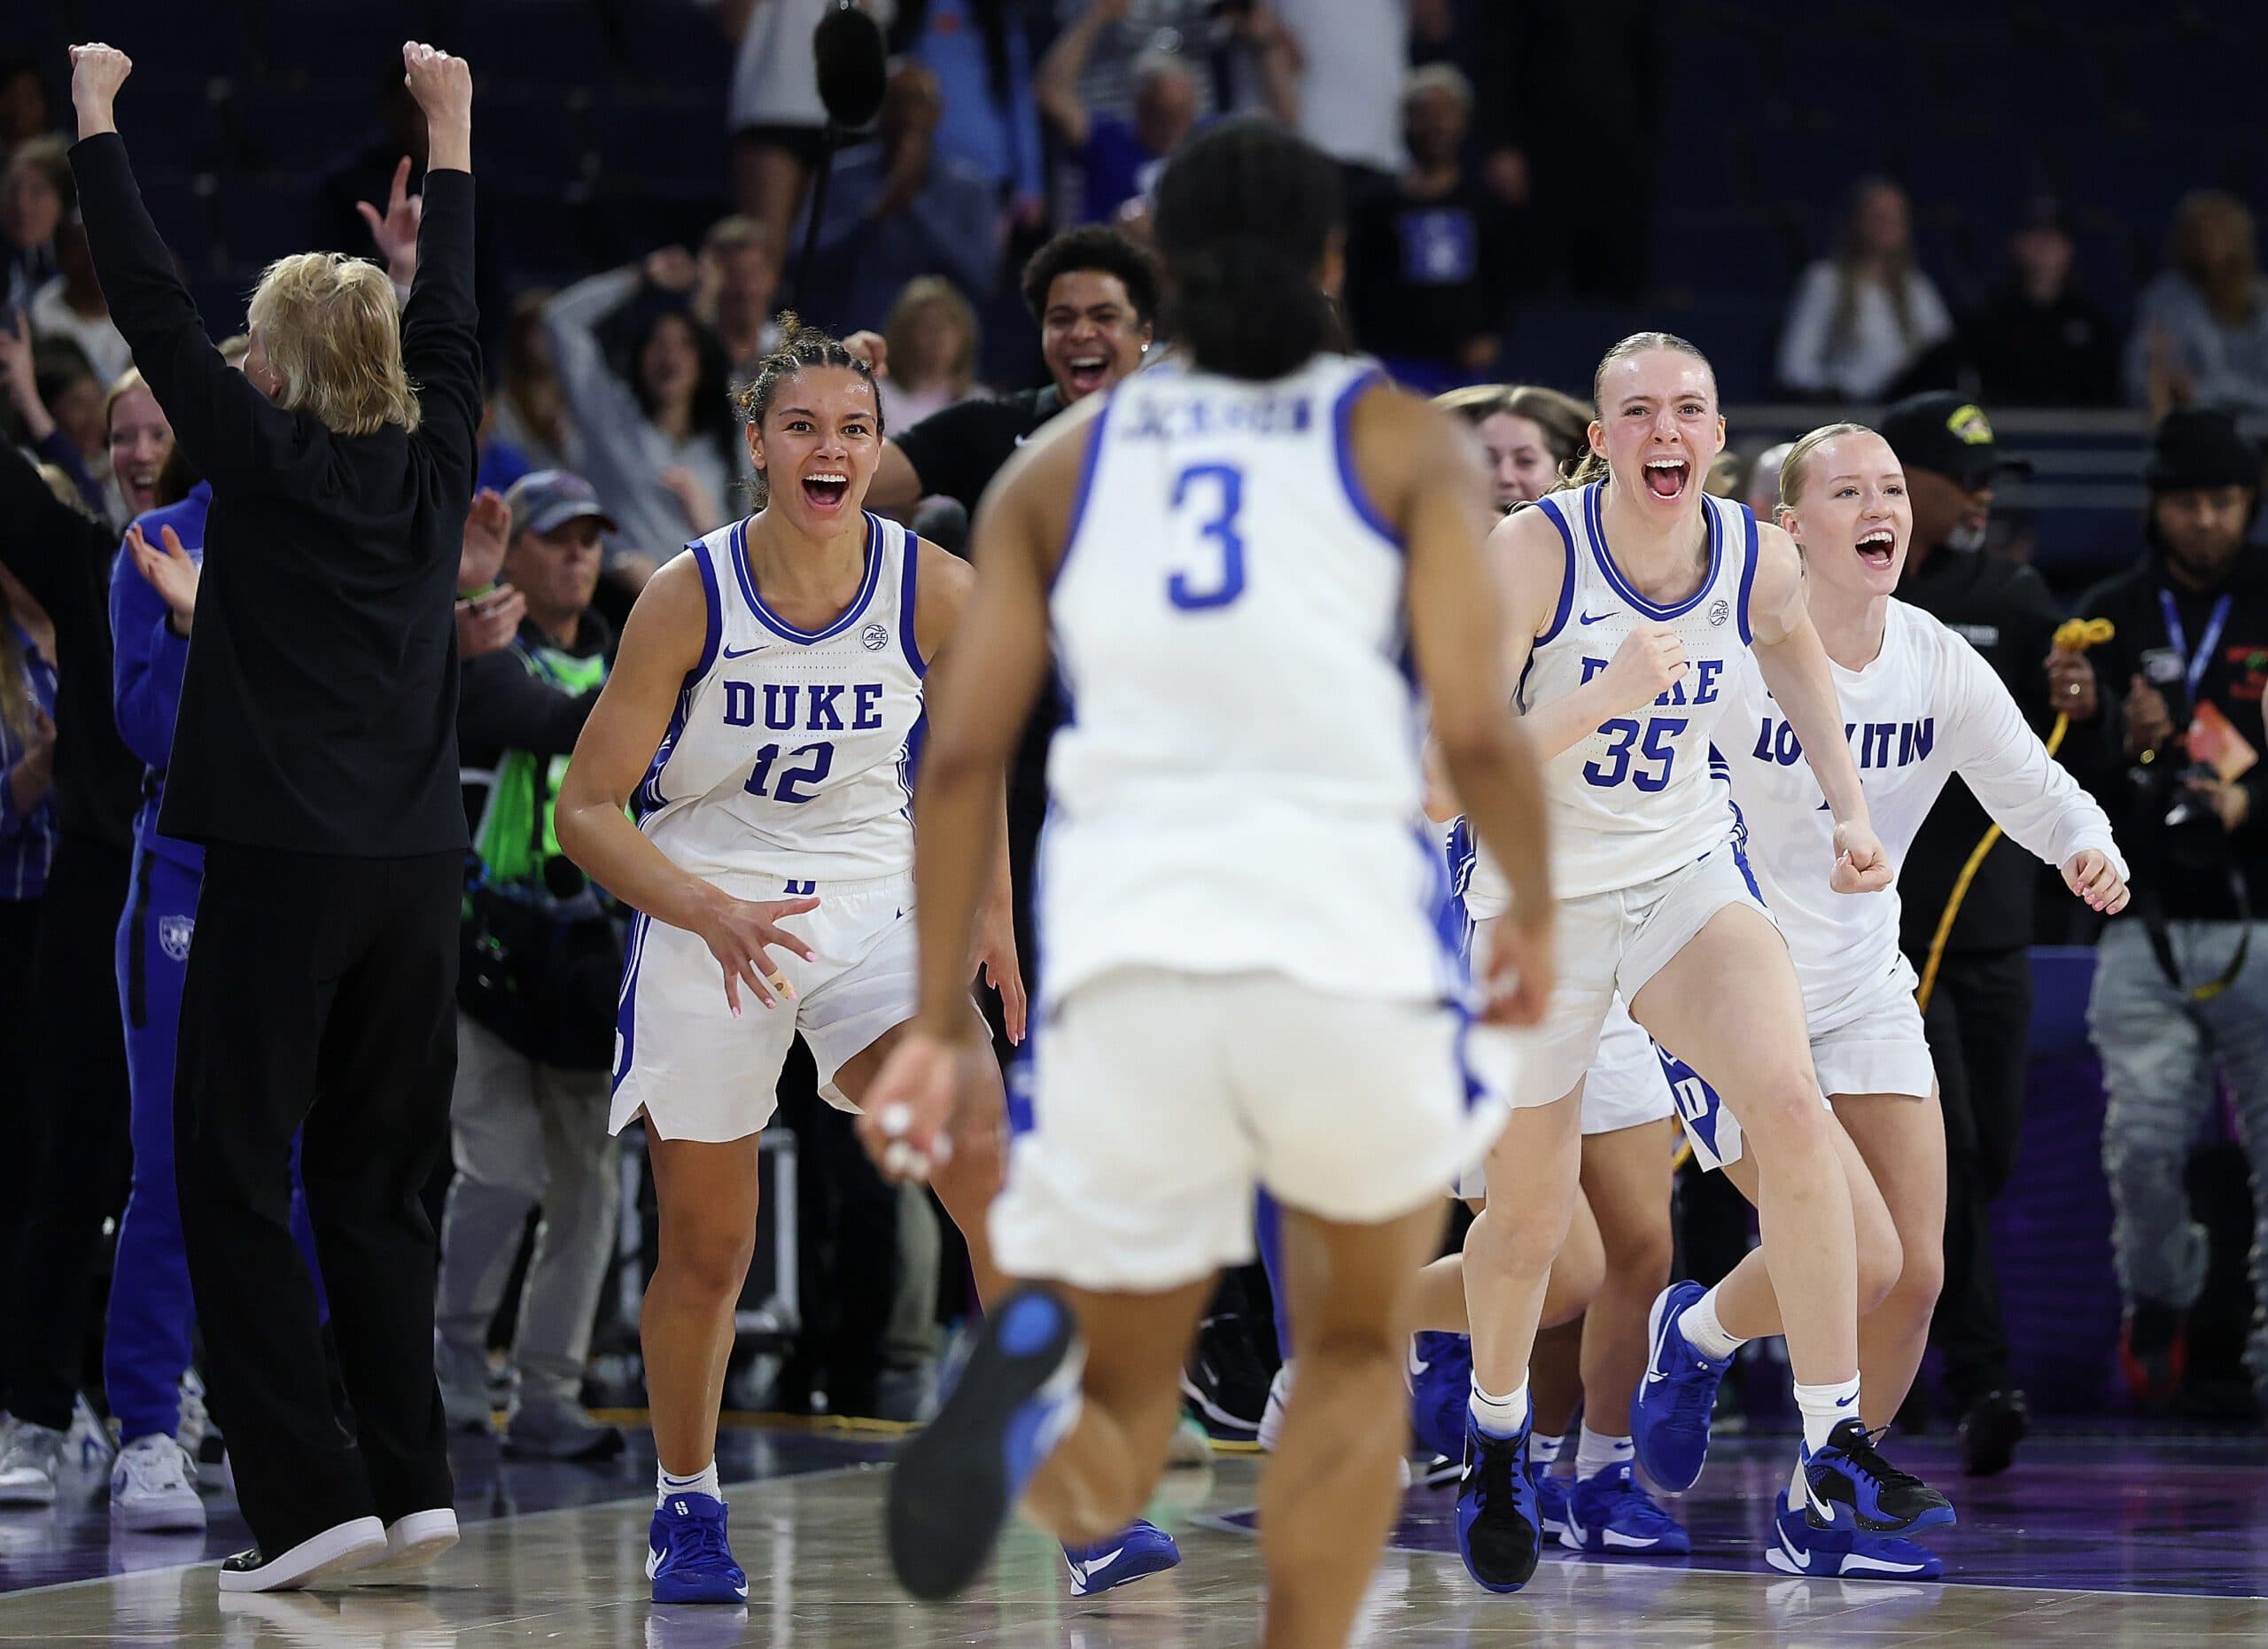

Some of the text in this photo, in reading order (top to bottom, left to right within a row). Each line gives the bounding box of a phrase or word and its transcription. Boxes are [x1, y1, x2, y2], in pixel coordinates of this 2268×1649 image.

[1169, 463, 1243, 611] 3
[723, 681, 882, 731] DUKE
[1580, 657, 1723, 706] DKE
[743, 742, 835, 805] 12
[1582, 718, 1689, 792] 35
[1674, 1077, 1708, 1122] D
